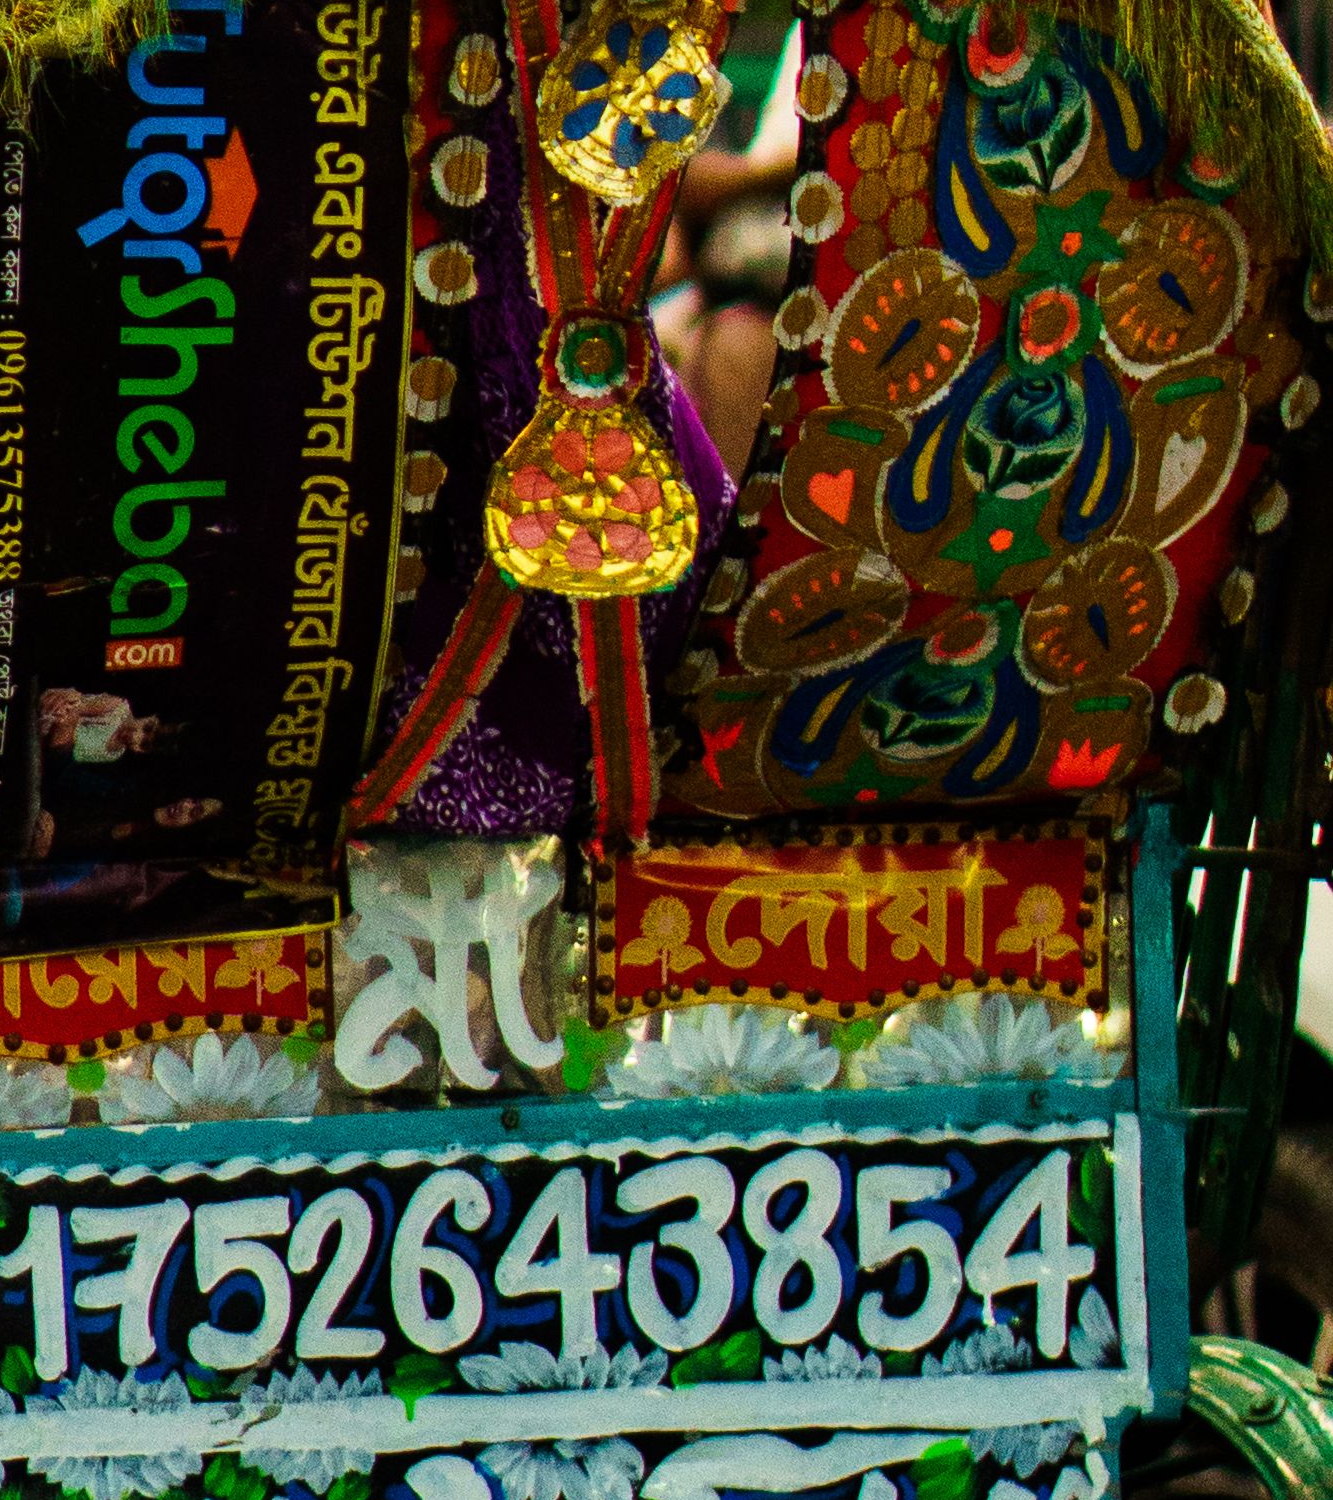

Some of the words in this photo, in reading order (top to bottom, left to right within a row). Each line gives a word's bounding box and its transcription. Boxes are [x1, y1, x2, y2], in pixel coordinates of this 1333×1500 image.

[3, 205, 23, 241] কল
[311, 142, 365, 259] এবং
[1, 250, 21, 304] করুন
[302, 274, 387, 461] টিউশন
[284, 475, 371, 647] খোঁজার
[105, 640, 180, 668] .com
[265, 657, 352, 765] বিশ্বস্ত
[706, 848, 1009, 971] দোয়া
[334, 850, 564, 1090] মা
